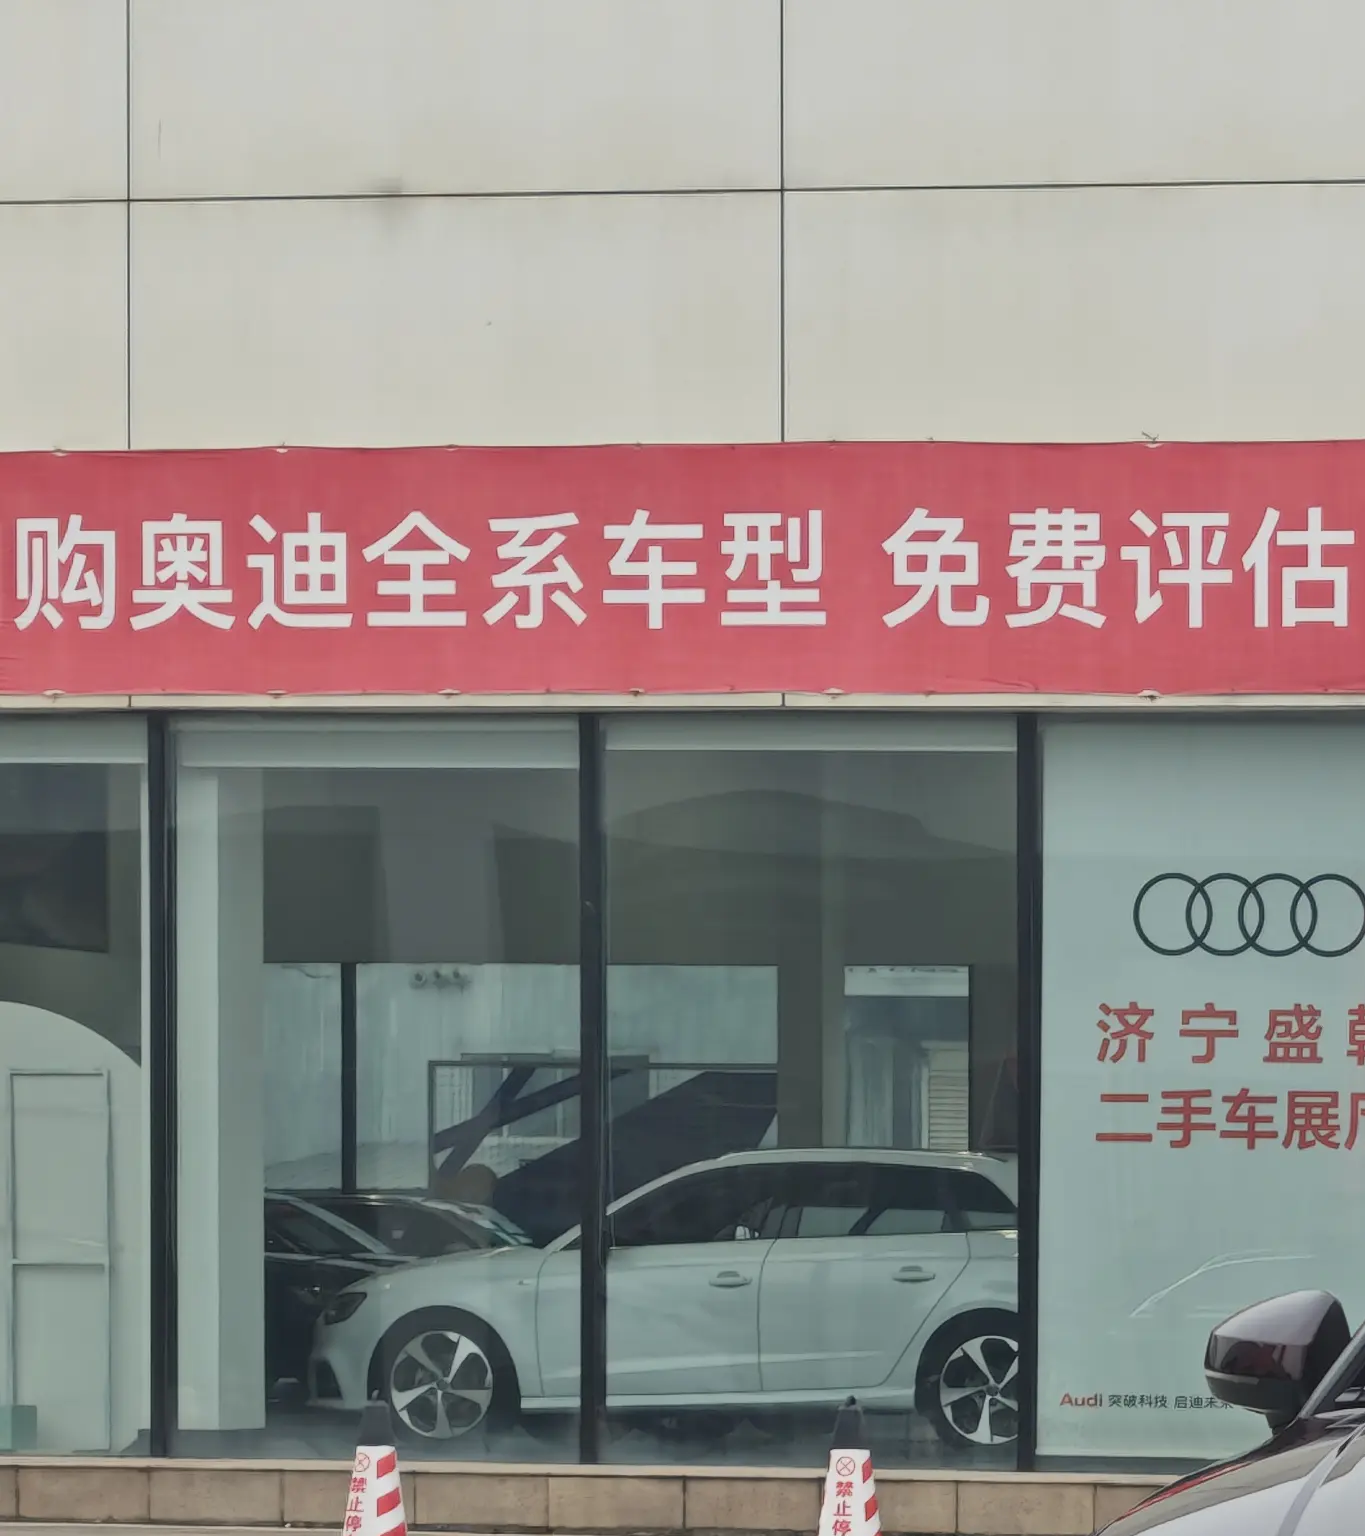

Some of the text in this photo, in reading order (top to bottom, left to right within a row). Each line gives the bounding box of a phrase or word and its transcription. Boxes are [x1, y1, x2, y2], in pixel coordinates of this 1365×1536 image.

[13, 506, 1356, 632] 购奥迪全系车型 免费评估
[1060, 1393, 1103, 1407] Audi
[1108, 1394, 1168, 1408] 突破科技
